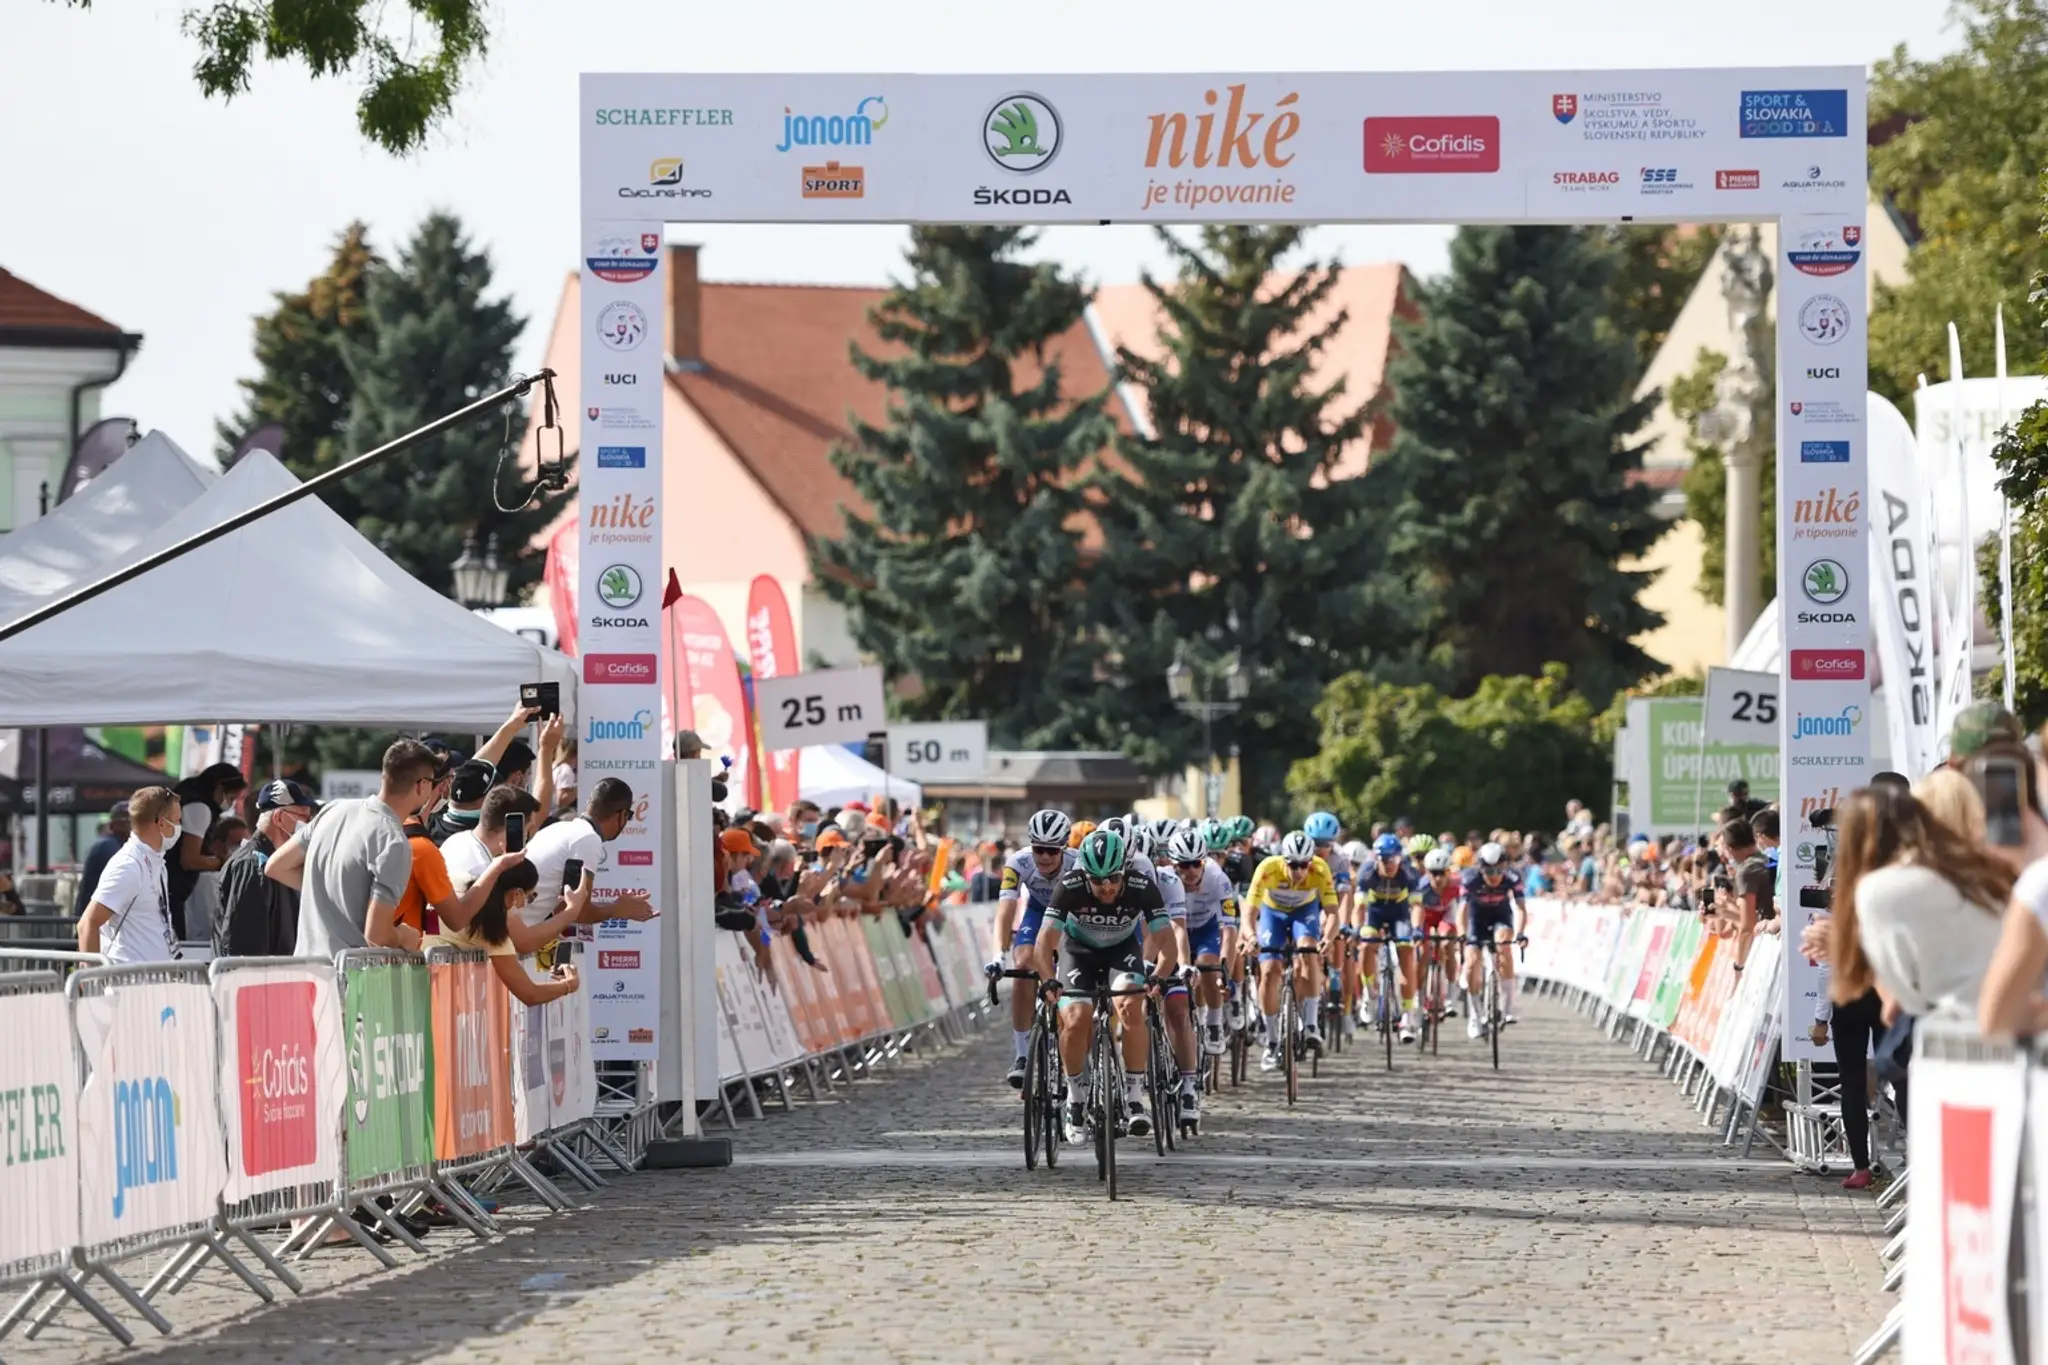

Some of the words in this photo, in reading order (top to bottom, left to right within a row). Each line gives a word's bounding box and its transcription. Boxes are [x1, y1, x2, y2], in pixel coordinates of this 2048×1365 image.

[1583, 92, 1662, 102] MINISTERSTVO
[1745, 95, 1792, 107] SPORT
[1796, 94, 1807, 106] &
[596, 109, 734, 126] SCHAEFFLER
[1745, 108, 1813, 120] SLOVAKIA
[775, 104, 872, 152] janom
[1144, 84, 1300, 169] niké
[1641, 119, 1649, 128] A
[1747, 121, 1794, 135] GOOD
[1651, 129, 1706, 139] REPUBLIKY
[1409, 133, 1486, 152] Cofidis
[1553, 171, 1620, 184] STRABAG
[805, 179, 862, 191] SPORT
[973, 186, 1073, 205] ŠKODA
[1142, 179, 1168, 210] je
[1174, 178, 1295, 210] tipovanie
[609, 374, 637, 385] UCI
[1813, 368, 1840, 379] UCI
[590, 493, 655, 529] niké
[1794, 487, 1860, 523] niké
[589, 532, 600, 546] je
[601, 532, 653, 545] tipovanie
[1793, 527, 1805, 541] je
[1806, 526, 1858, 540] tipovanie
[591, 616, 650, 628] ŠKODA
[1797, 611, 1856, 623] ŠKODA
[607, 663, 650, 674] Cofidis
[1815, 658, 1858, 670] Cofidis
[781, 695, 826, 729] 25
[838, 703, 863, 722] m
[1731, 690, 1779, 725] 25
[584, 716, 643, 744] janom
[1792, 711, 1852, 740] janom
[907, 740, 941, 763] 50
[950, 750, 970, 762] m
[584, 760, 656, 770] SCHAEFFLER
[1791, 756, 1865, 766] SCHAEFFLER
[1078, 914, 1132, 925] BORA
[373, 1022, 425, 1099] ŠKODA
[262, 1042, 308, 1099] Cofds
